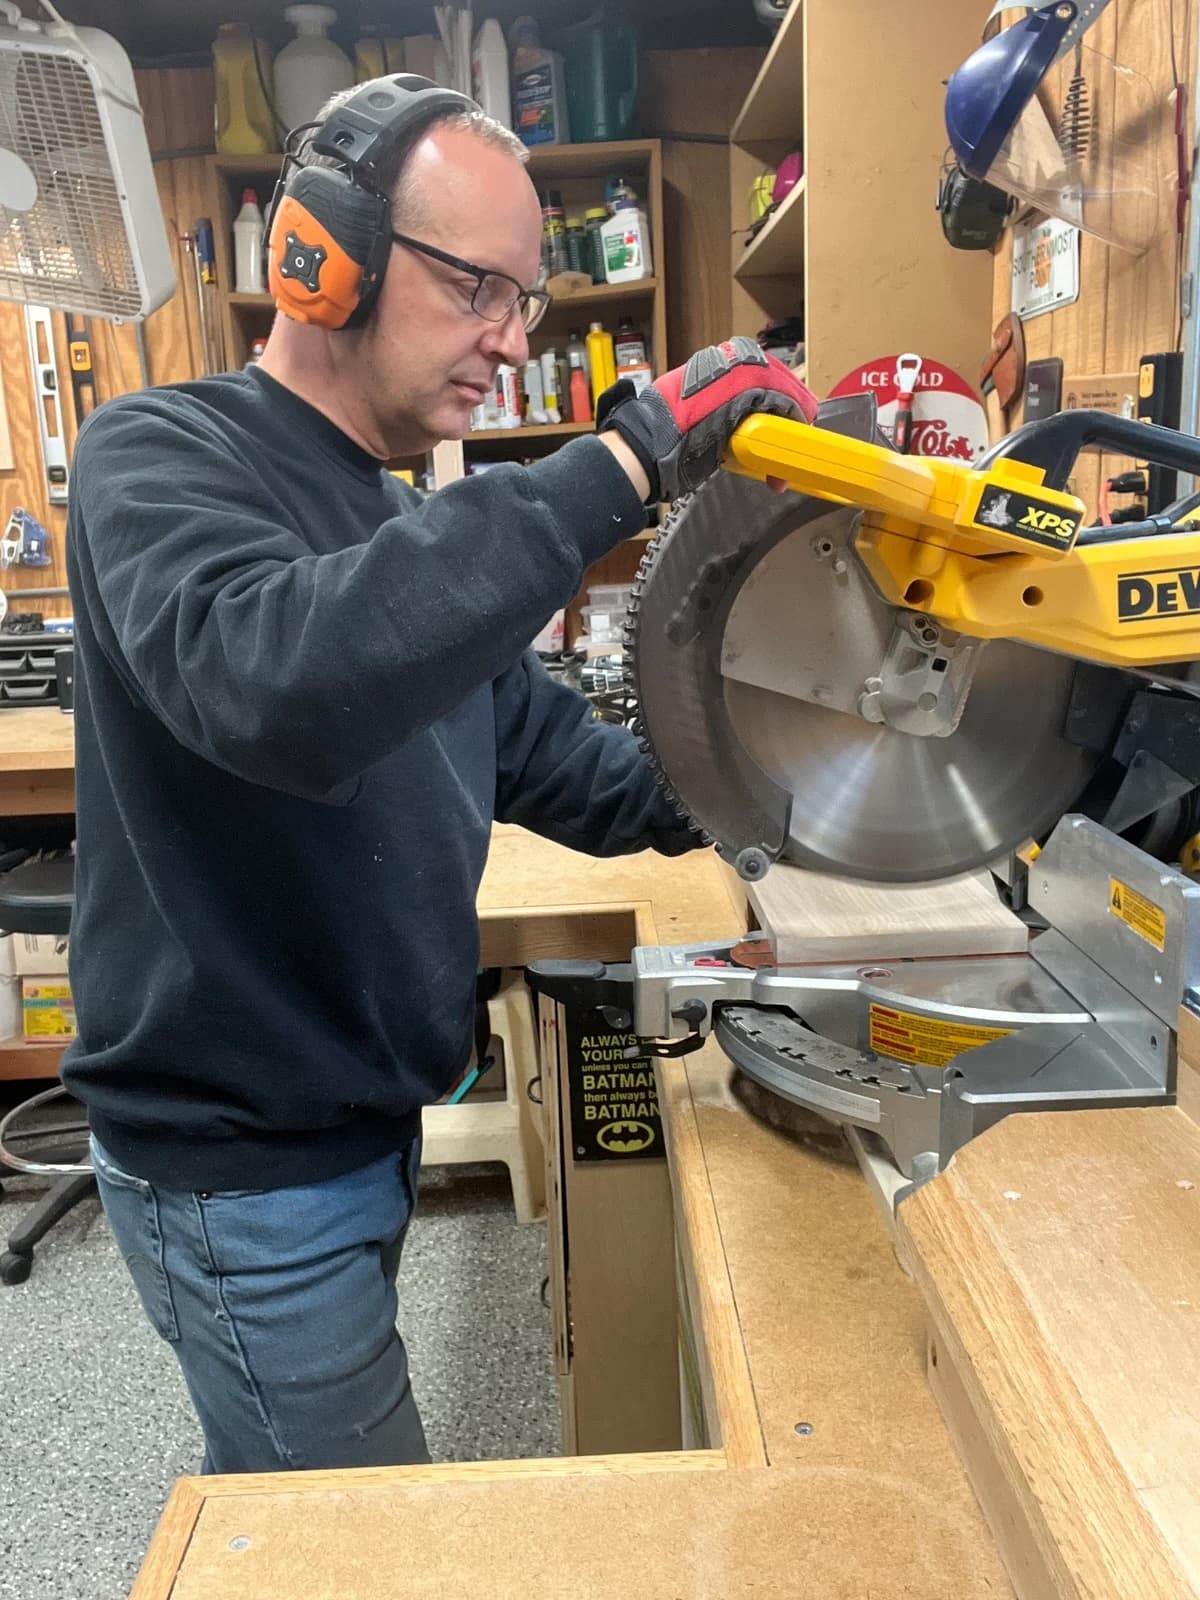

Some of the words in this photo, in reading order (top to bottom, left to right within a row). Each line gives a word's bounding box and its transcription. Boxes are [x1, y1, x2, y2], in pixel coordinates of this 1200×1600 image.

[860, 371, 889, 387] ICE
[1018, 506, 1076, 538] XPS
[581, 1033, 638, 1049] ALWAYS
[581, 1063, 611, 1073] unless
[612, 1063, 630, 1073] you
[631, 1061, 649, 1070] can
[583, 1071, 657, 1091] BATMAN
[584, 1092, 608, 1103] then
[609, 1090, 646, 1102] always
[584, 1102, 661, 1121] BATMAN
